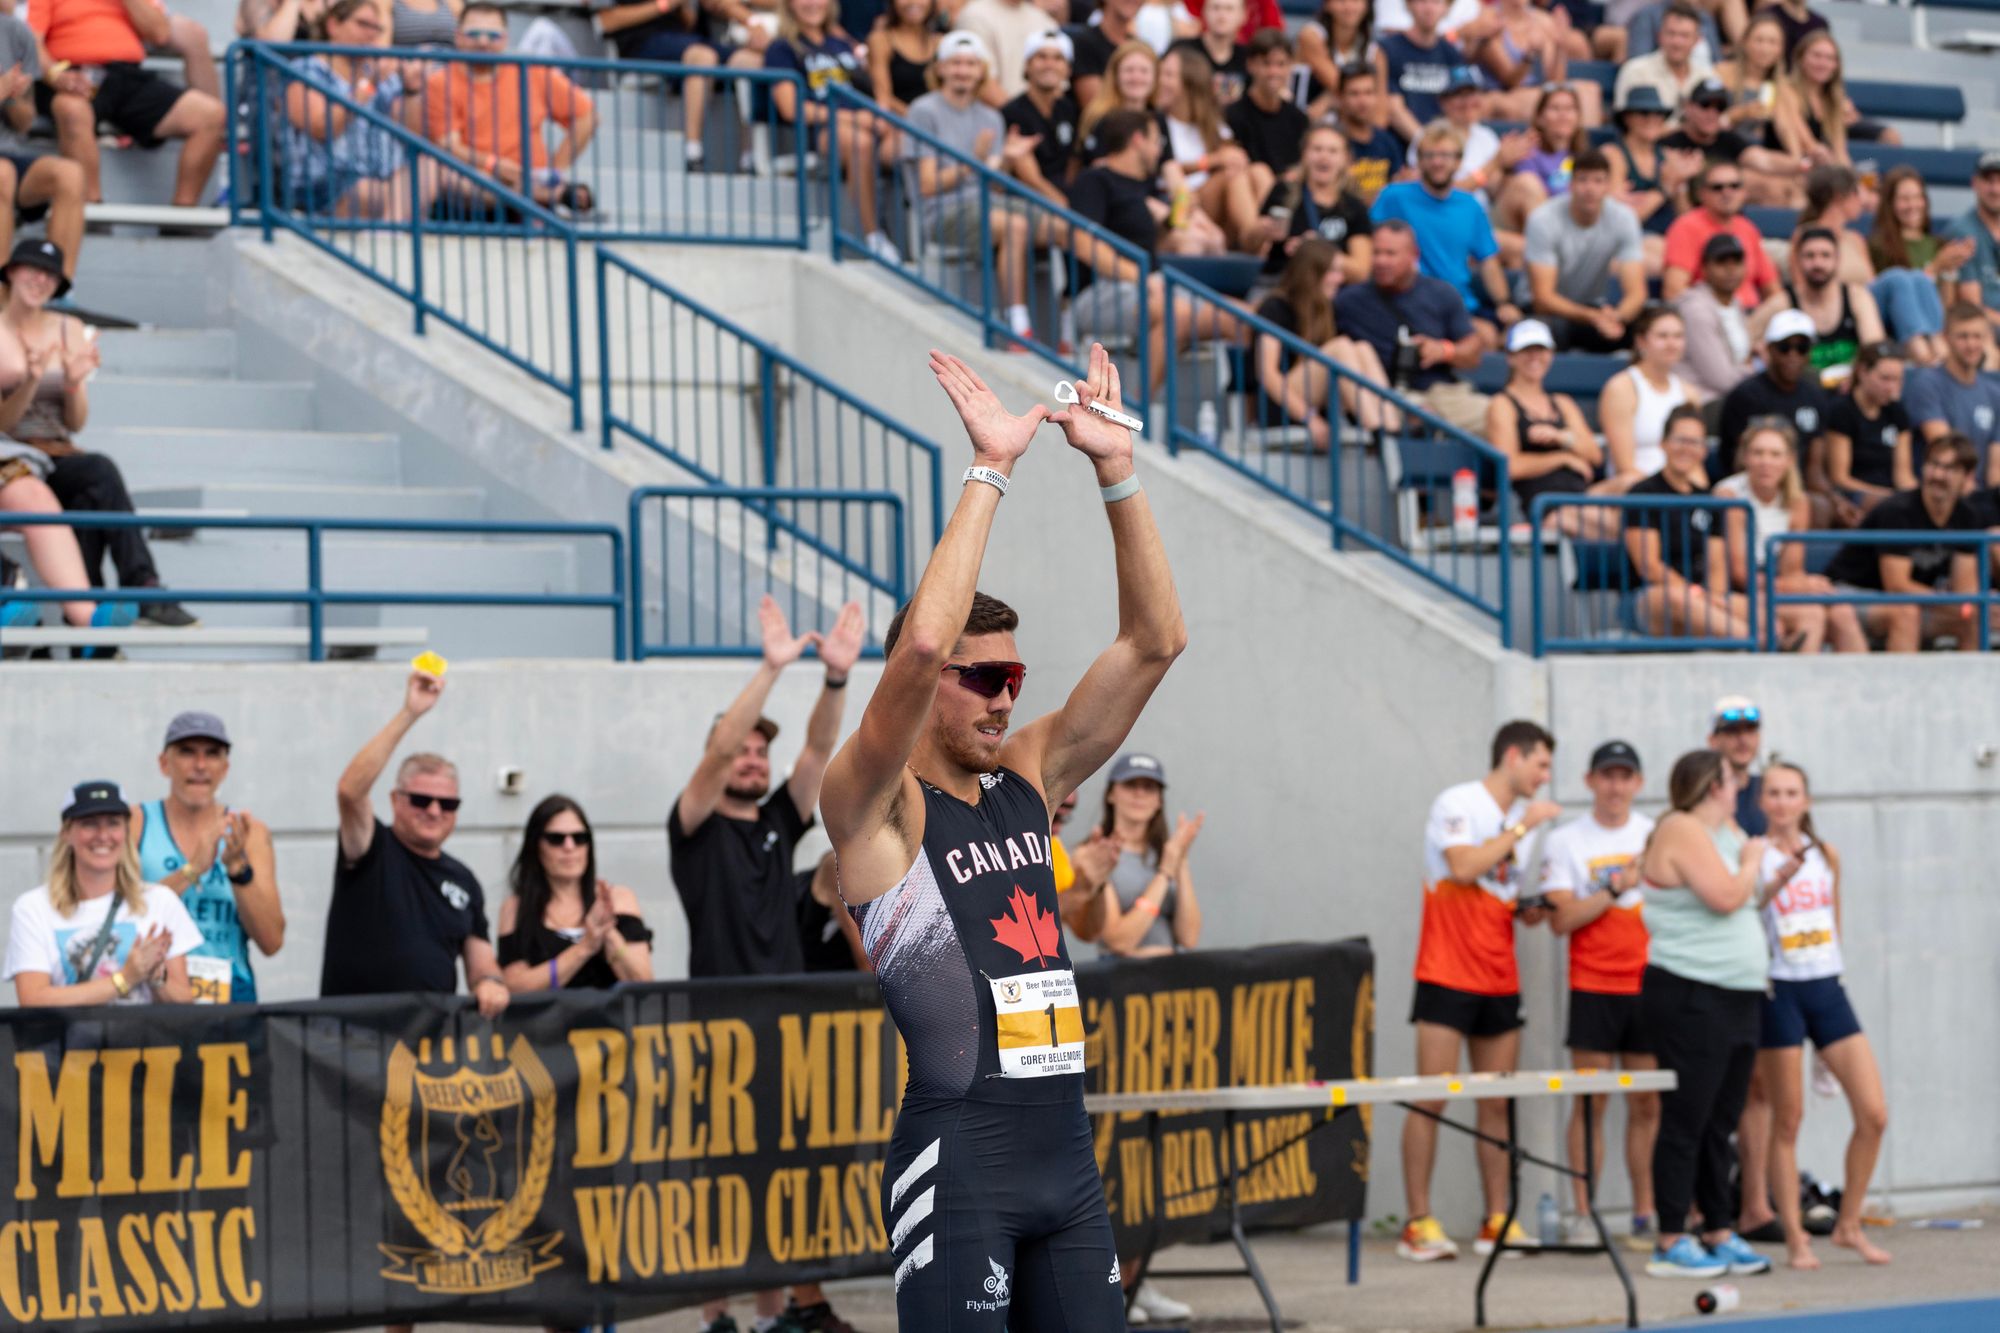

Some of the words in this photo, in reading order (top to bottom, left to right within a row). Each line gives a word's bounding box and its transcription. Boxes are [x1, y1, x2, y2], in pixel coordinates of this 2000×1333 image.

[945, 831, 1054, 884] CANADA
[1025, 981, 1040, 990] Beer
[1041, 979, 1054, 988] Mile
[1042, 989, 1063, 998] Windsor
[1044, 1003, 1059, 1048] 1
[1020, 1054, 1047, 1066] COREY
[1048, 1050, 1082, 1063] BELLEMORE
[1041, 1065, 1055, 1073] TEAM
[1055, 1063, 1072, 1072] CANADA
[568, 1018, 758, 1169] BEER
[779, 1010, 909, 1151] MIL
[14, 1042, 252, 1200] MILE
[573, 1174, 753, 1284] WORLD
[0, 1206, 262, 1323] CLASSIC
[966, 1300, 996, 1312] Flying
